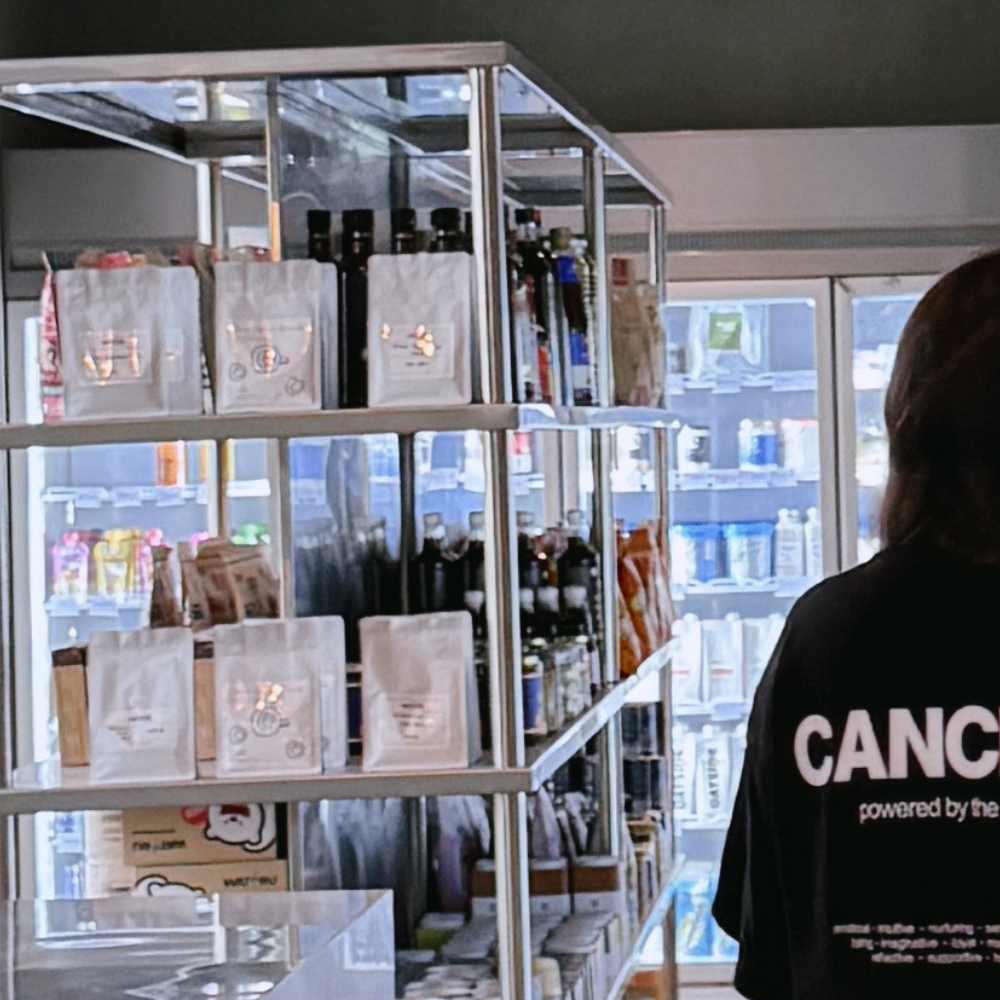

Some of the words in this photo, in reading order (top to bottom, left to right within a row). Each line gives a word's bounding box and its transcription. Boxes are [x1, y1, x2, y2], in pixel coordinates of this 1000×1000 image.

[859, 797, 941, 824] powered
[945, 797, 969, 823] by
[971, 797, 999, 819] the
